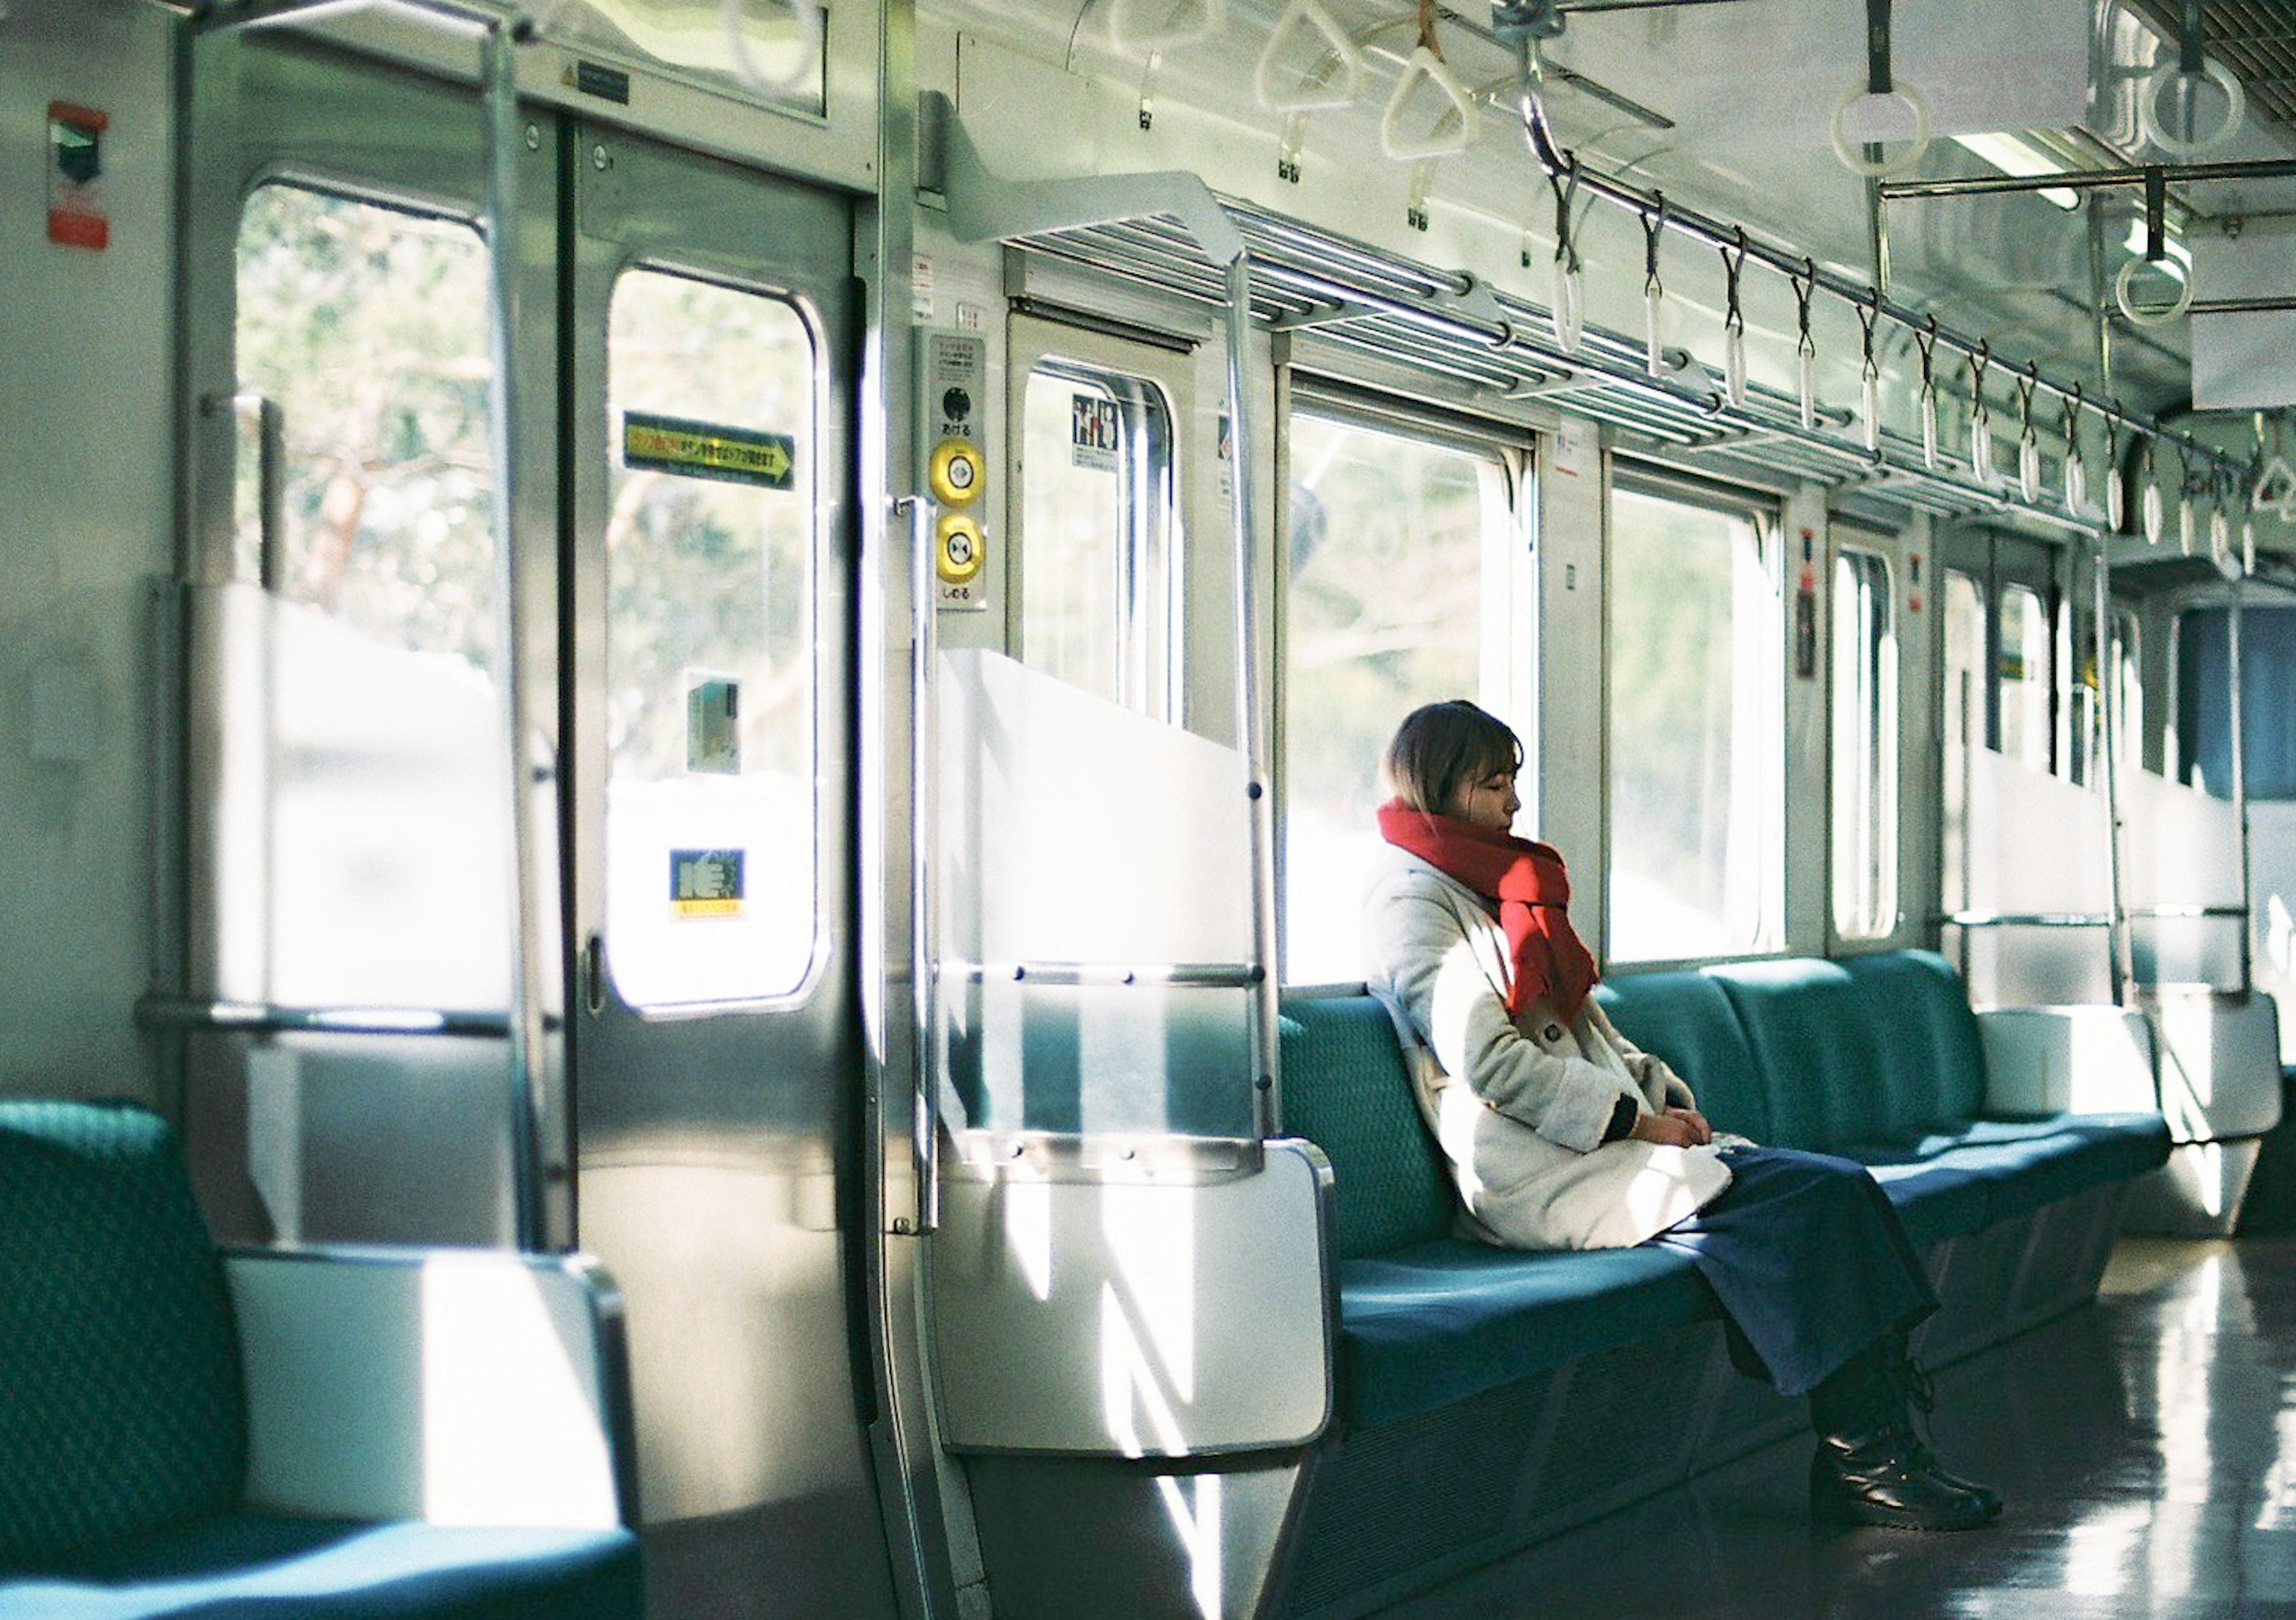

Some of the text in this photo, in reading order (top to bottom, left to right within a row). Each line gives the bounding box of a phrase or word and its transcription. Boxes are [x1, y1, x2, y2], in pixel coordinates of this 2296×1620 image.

[942, 423, 970, 437] あける
[943, 587, 969, 599] しめる
